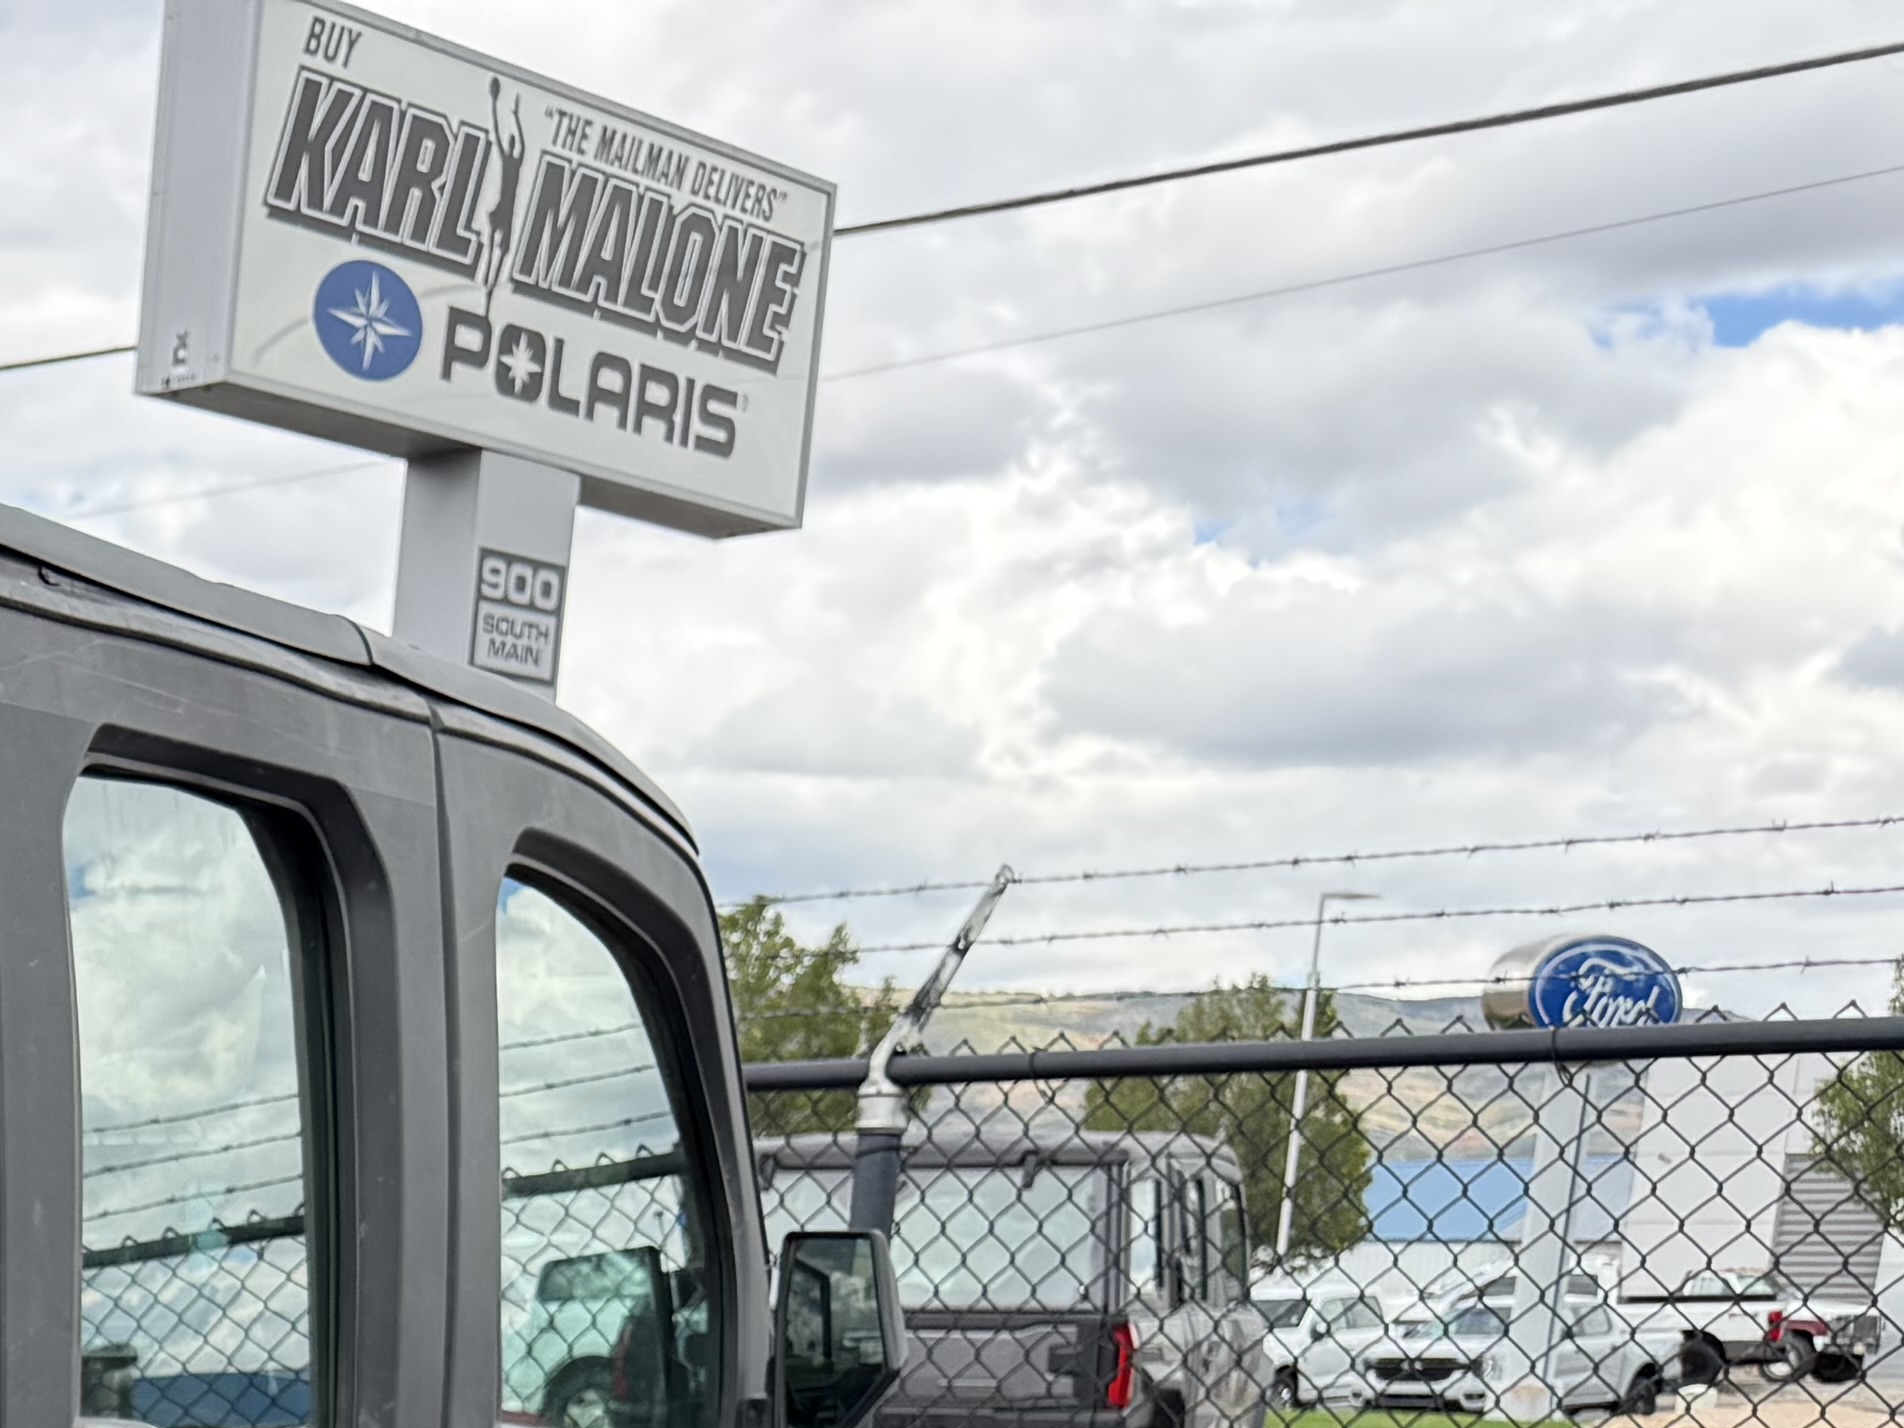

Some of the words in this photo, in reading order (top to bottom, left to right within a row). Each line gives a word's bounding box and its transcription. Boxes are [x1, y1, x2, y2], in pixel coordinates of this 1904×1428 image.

[303, 14, 363, 69] BUY
[593, 125, 690, 191] MAILMAN
[264, 66, 490, 275] KARL
[511, 150, 807, 369] MALONE
[439, 306, 738, 460] POLARIS
[480, 557, 561, 612] 900
[481, 611, 550, 645] SOUTH
[487, 637, 541, 667] MAIN
